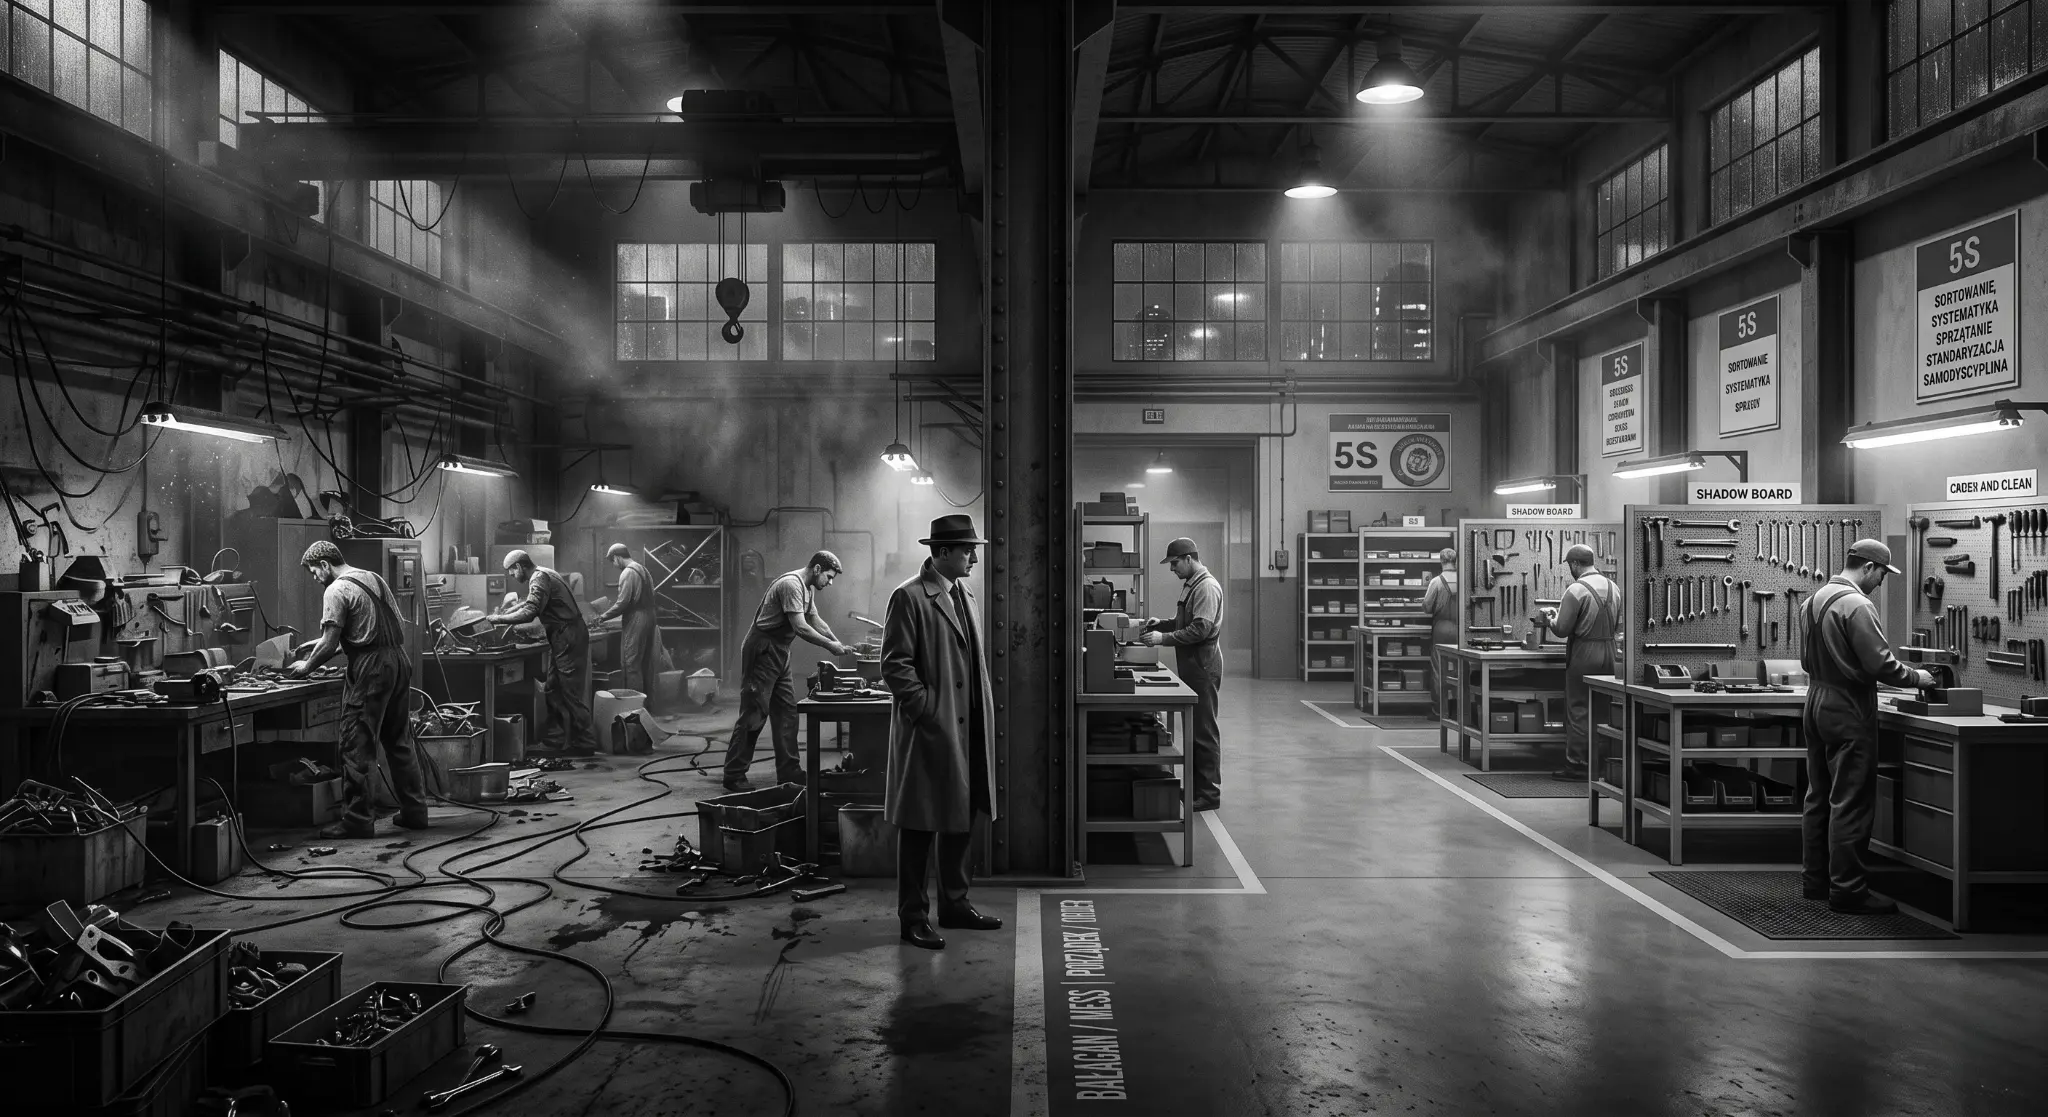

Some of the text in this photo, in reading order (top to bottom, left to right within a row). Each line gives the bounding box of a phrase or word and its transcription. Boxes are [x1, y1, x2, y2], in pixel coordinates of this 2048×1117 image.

[1949, 235, 1981, 274] 5S
[1934, 279, 1997, 308] SORTOWANIE,
[1738, 311, 1757, 338] 5S
[1931, 299, 1999, 328] SYSTEMATYKA
[1935, 320, 1993, 346] SPRZĄTANIE
[1614, 355, 1628, 377] 5S
[1926, 338, 2005, 367] STANDARYZACJA
[1725, 374, 1771, 394] SYSTEMATYKA
[1923, 358, 2008, 387] SAMODYSCYPLINA
[1334, 441, 1378, 469] 5S
[1696, 489, 1793, 499] SHADOW BOARD
[1980, 480, 1999, 492] AND
[2001, 477, 2032, 490] CLEAN
[1511, 508, 1573, 516] SHADOW BOARD
[1068, 989, 1114, 1020] MESS
[1072, 1035, 1127, 1100] BAŁAGAN
